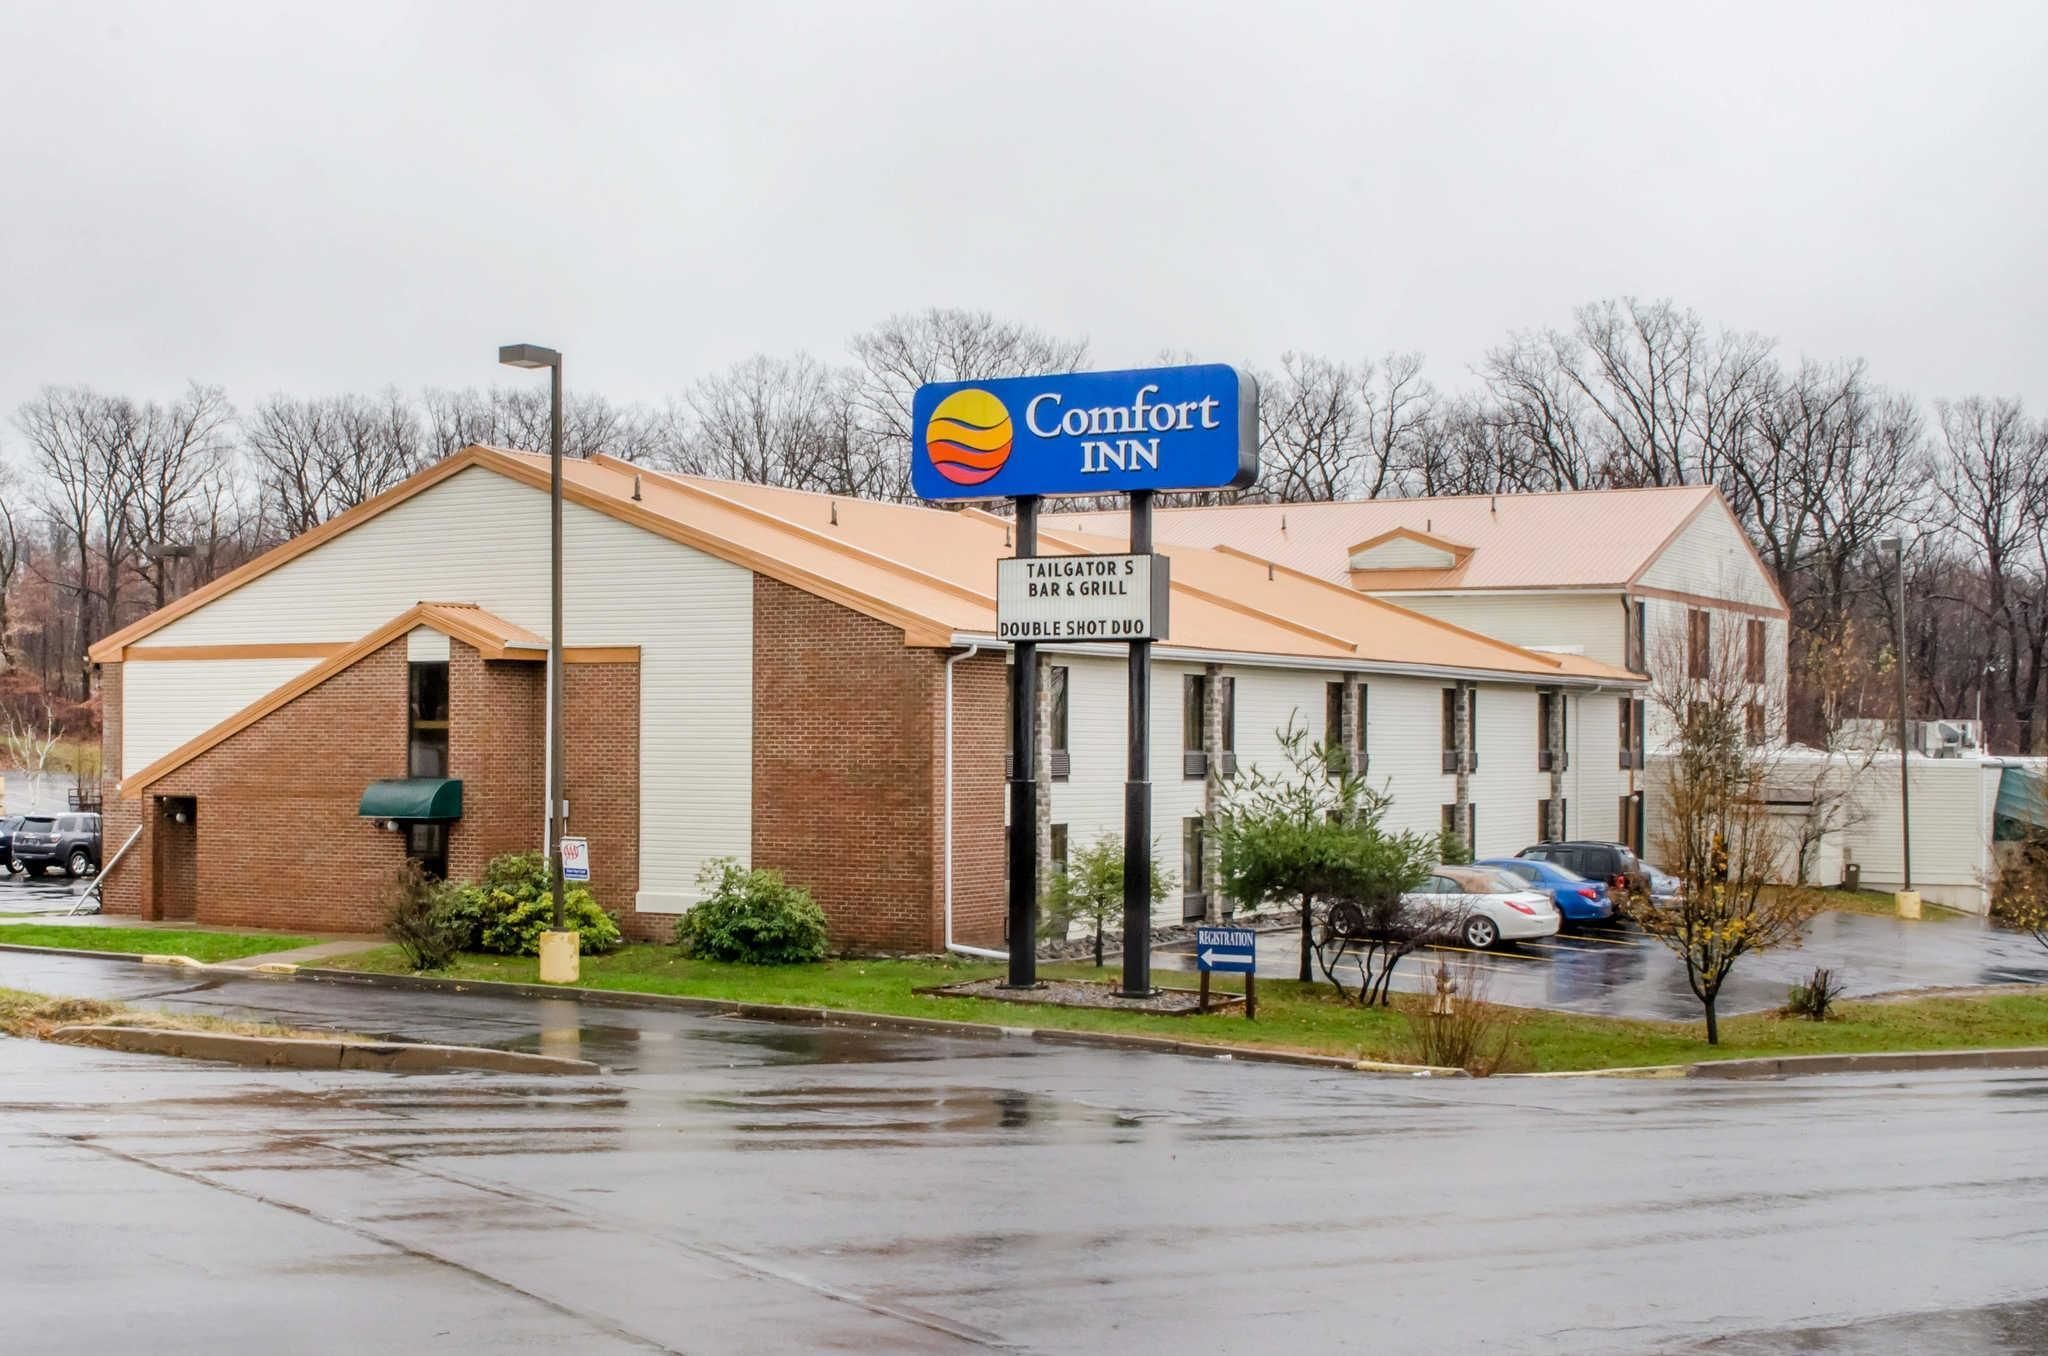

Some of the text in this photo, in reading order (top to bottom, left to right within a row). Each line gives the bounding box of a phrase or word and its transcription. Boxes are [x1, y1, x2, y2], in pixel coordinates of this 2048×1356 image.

[1025, 385, 1220, 438] Comfort
[1080, 438, 1160, 473] INN
[1028, 580, 1128, 598] BAR & GRILL
[1000, 619, 1144, 637] DOUBLE SHOT DUO
[1199, 930, 1253, 947] REGISTRATION
